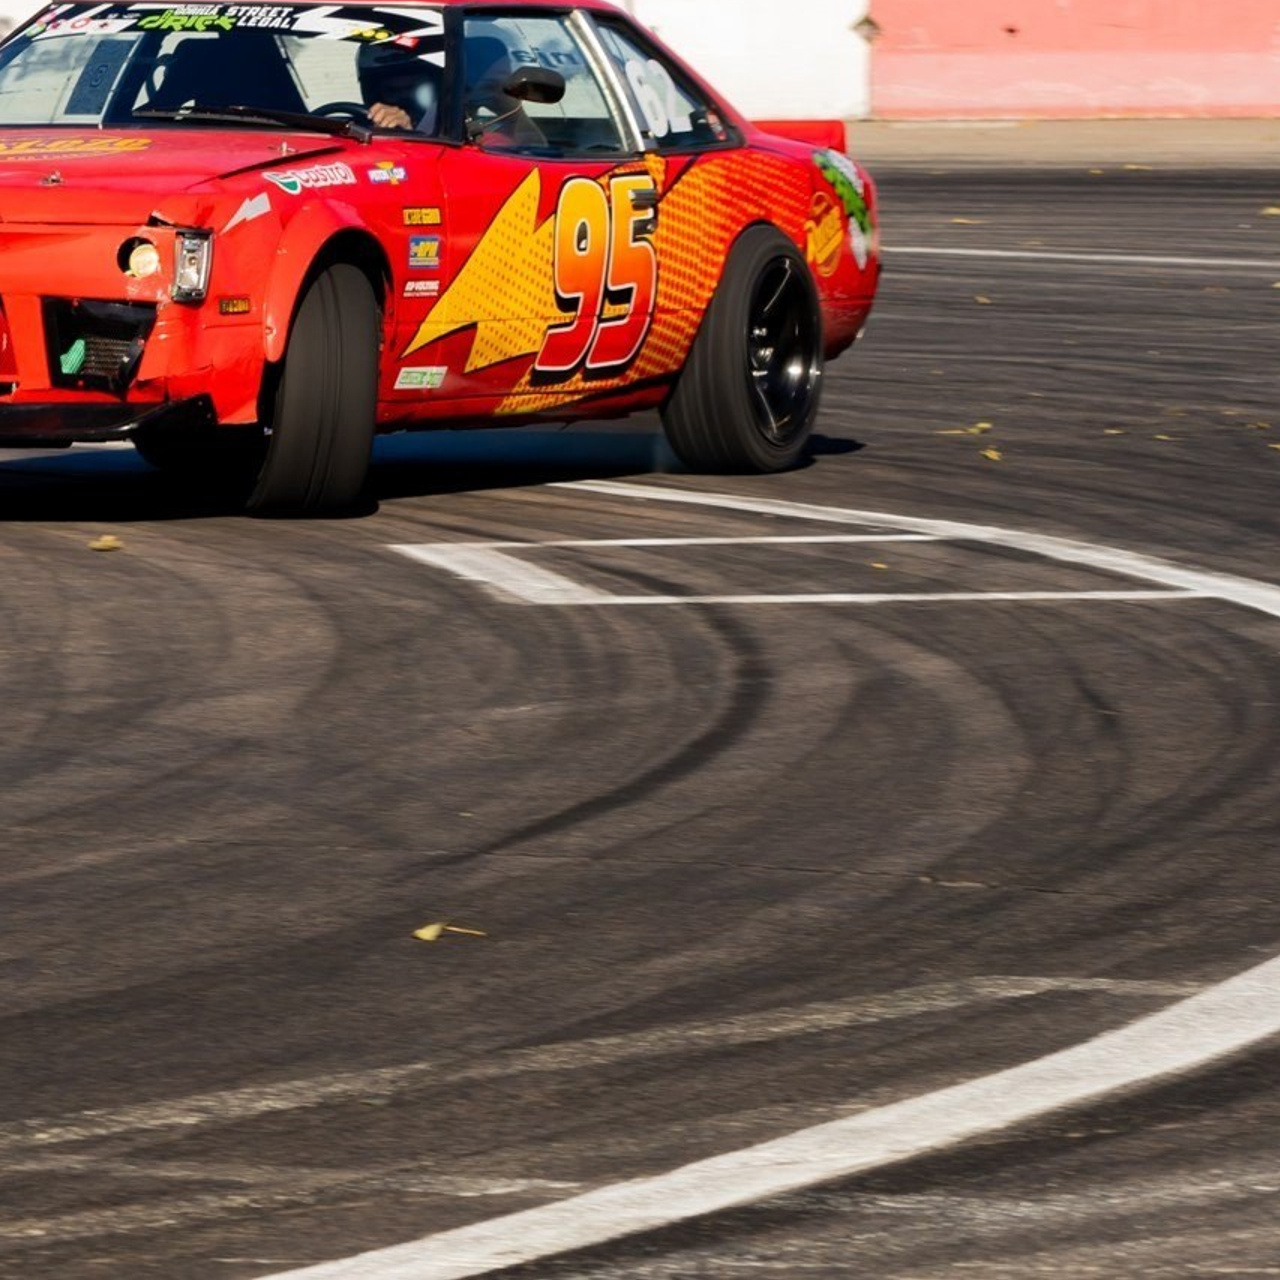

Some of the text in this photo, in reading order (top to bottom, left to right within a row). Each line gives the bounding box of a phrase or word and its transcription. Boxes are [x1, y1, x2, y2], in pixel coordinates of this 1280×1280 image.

[225, 6, 293, 17] STREET
[237, 16, 291, 28] LEGAL
[292, 163, 357, 187] Castrol
[533, 174, 657, 375] 95
